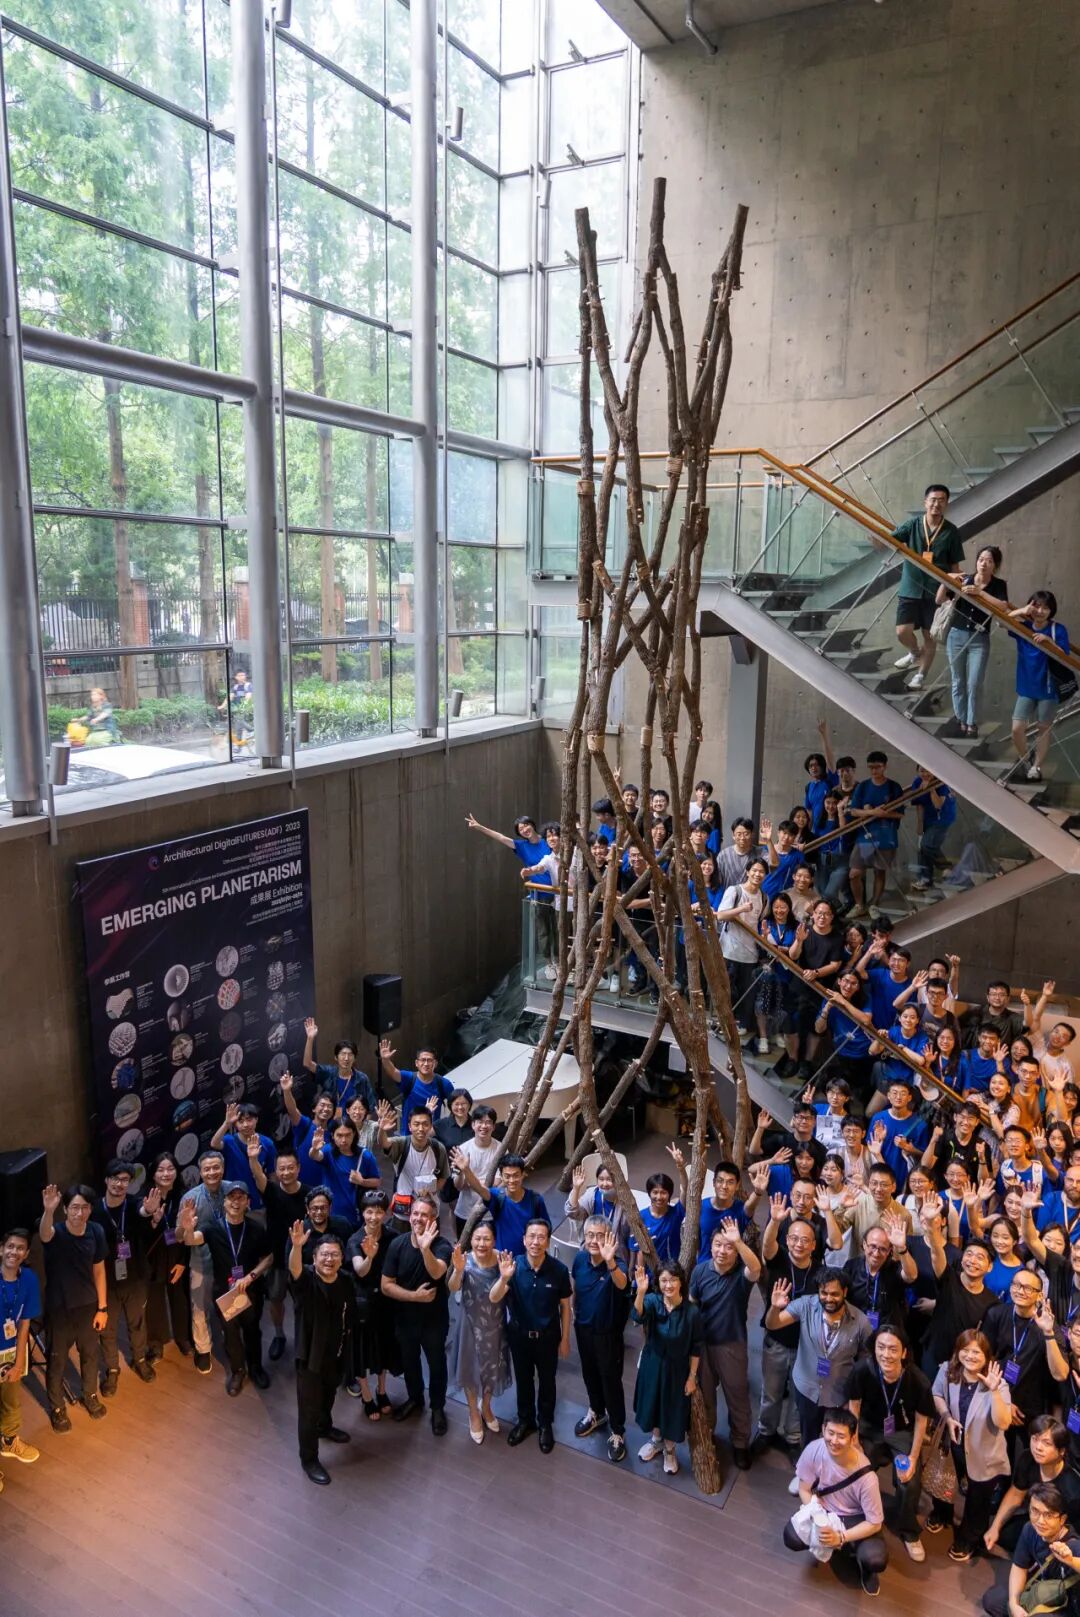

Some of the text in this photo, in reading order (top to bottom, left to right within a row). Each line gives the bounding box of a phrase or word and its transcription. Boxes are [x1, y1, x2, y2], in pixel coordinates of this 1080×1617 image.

[163, 843, 214, 863] Architectural
[285, 821, 301, 832] 2023
[100, 890, 197, 936] EMERGING
[201, 860, 302, 904] PLANETARISM
[272, 882, 303, 898] Exhibition
